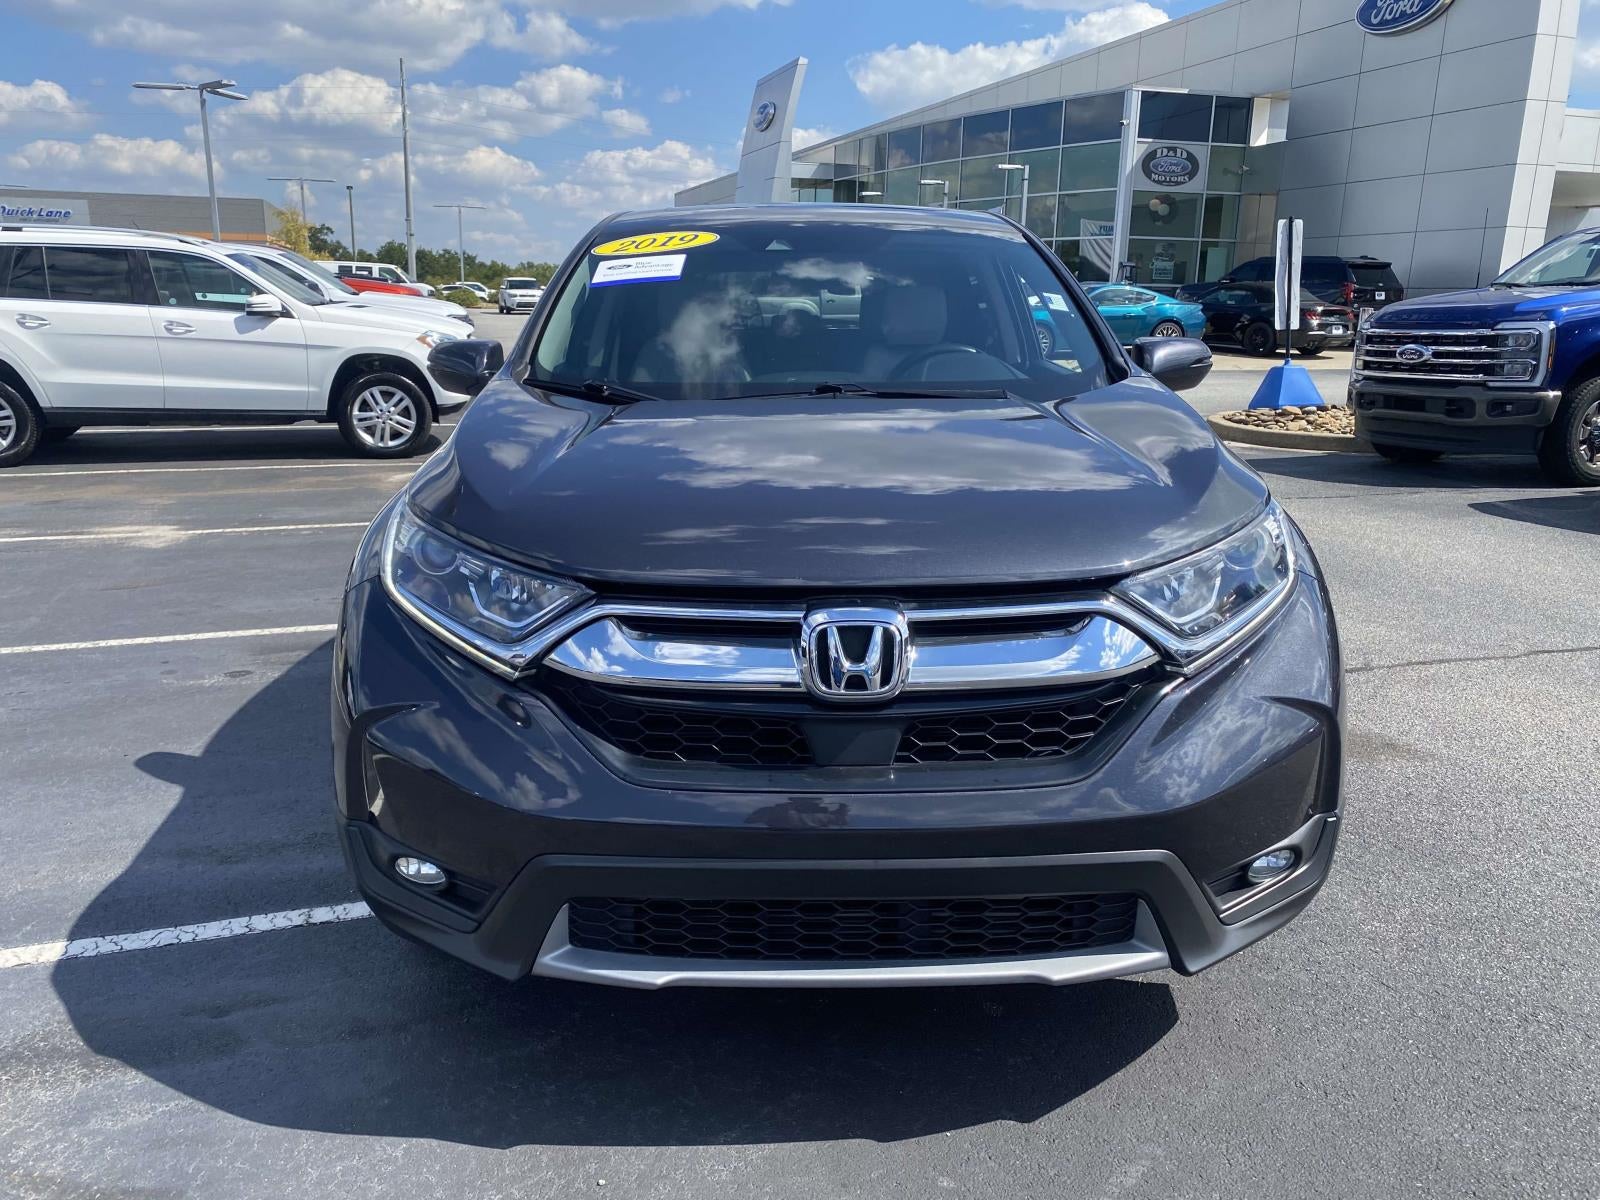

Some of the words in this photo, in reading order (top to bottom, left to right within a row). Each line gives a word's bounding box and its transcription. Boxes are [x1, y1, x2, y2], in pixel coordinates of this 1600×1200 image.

[1370, 0, 1423, 24] Ford
[1156, 147, 1188, 159] D&D
[1158, 160, 1184, 172] Ford
[1151, 173, 1190, 182] MOTORS
[37, 207, 72, 218] Lane
[611, 233, 700, 253] 2019
